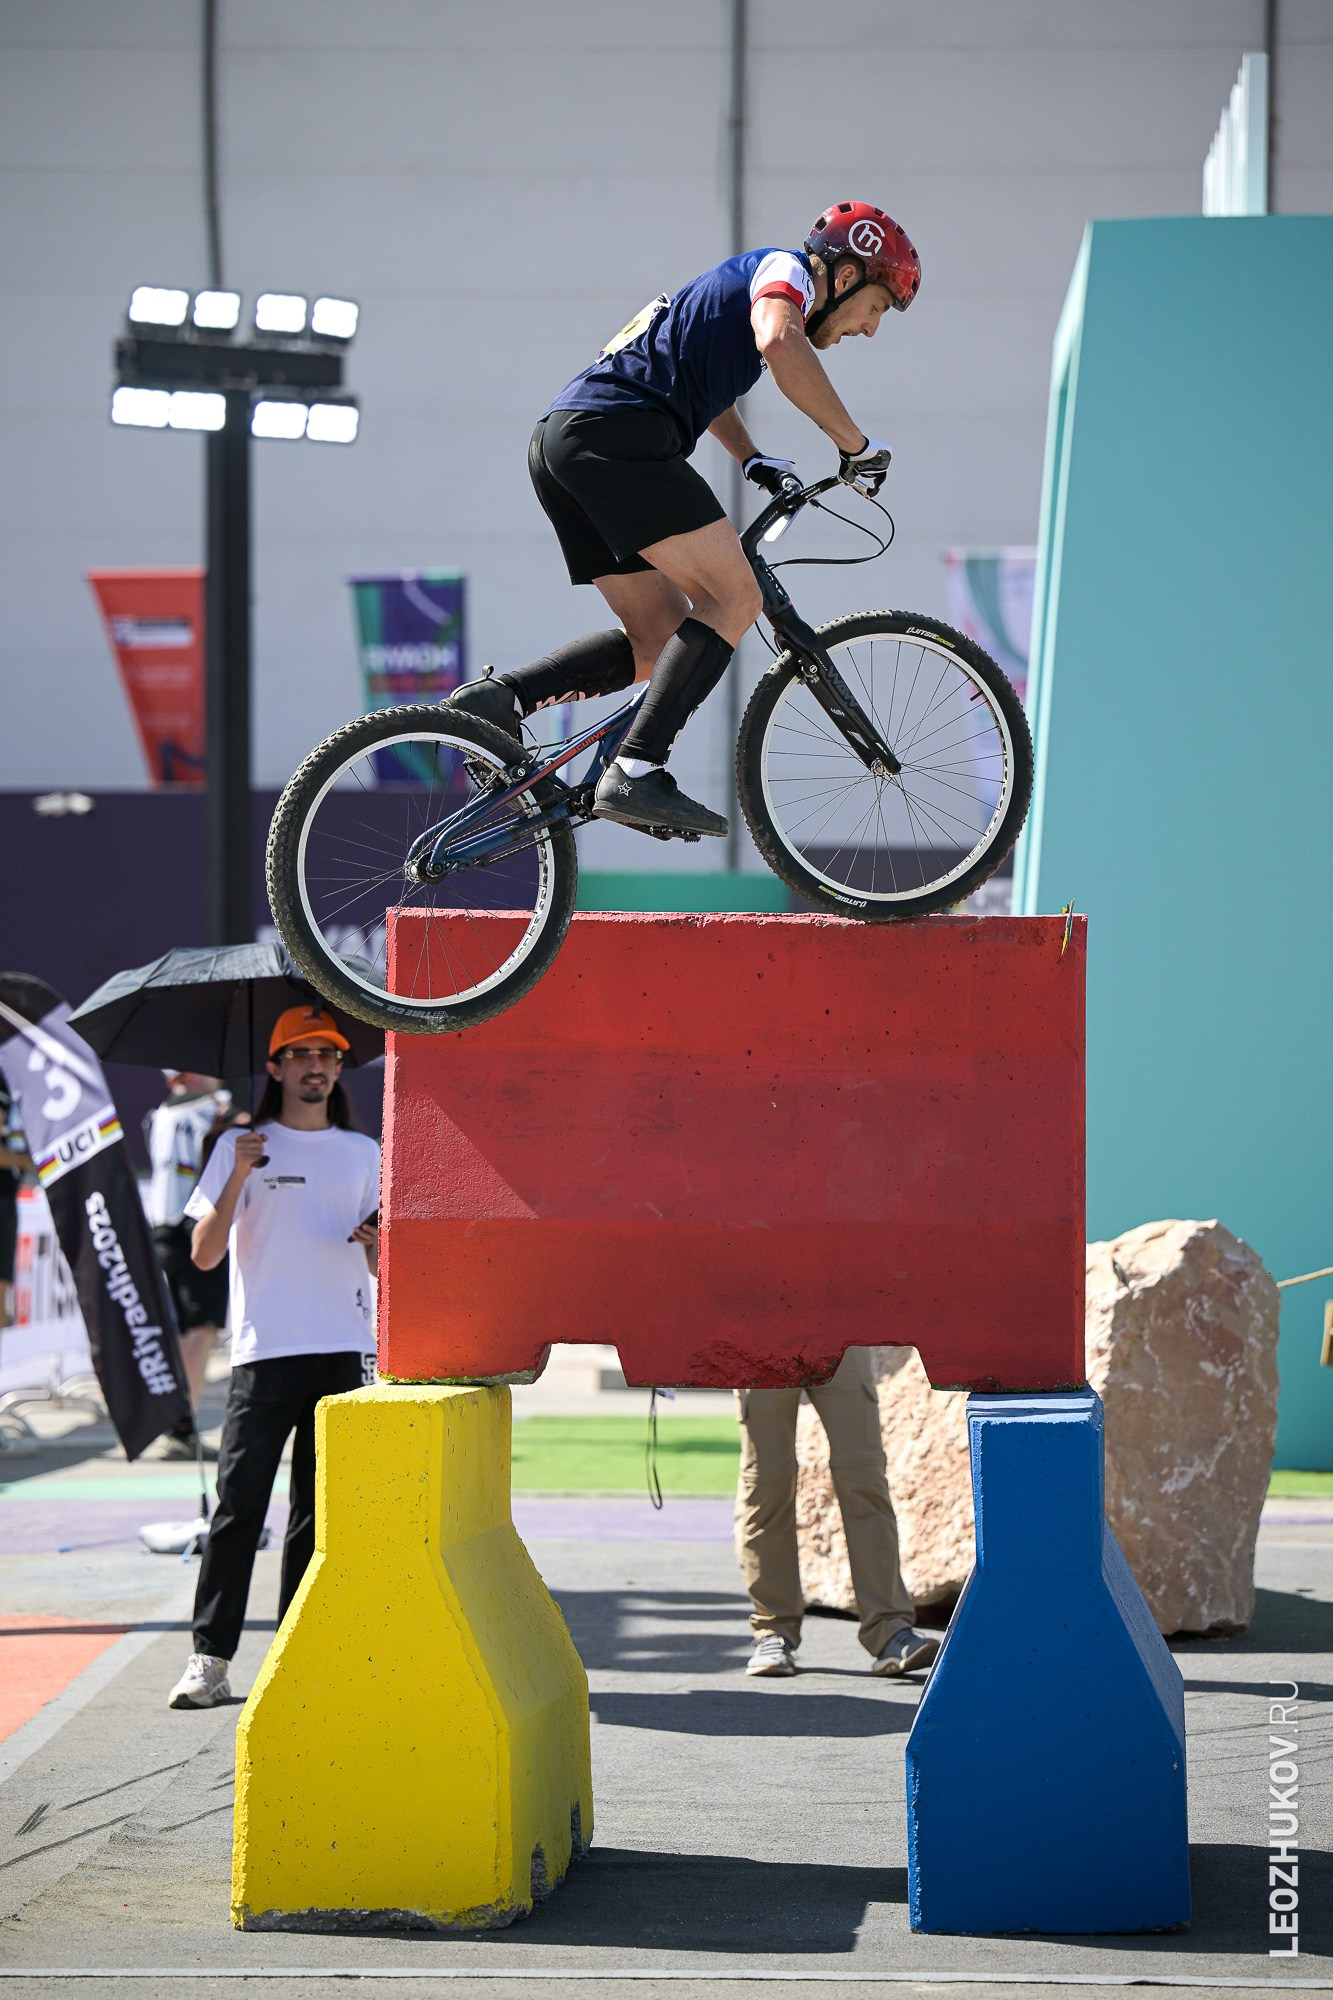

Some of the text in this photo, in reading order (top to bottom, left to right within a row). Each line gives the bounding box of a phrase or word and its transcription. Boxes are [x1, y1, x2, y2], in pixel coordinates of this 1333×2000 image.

[576, 728, 606, 752] CURVE
[58, 1128, 97, 1163] UCI
[85, 1190, 178, 1397] #Riyadh2025
